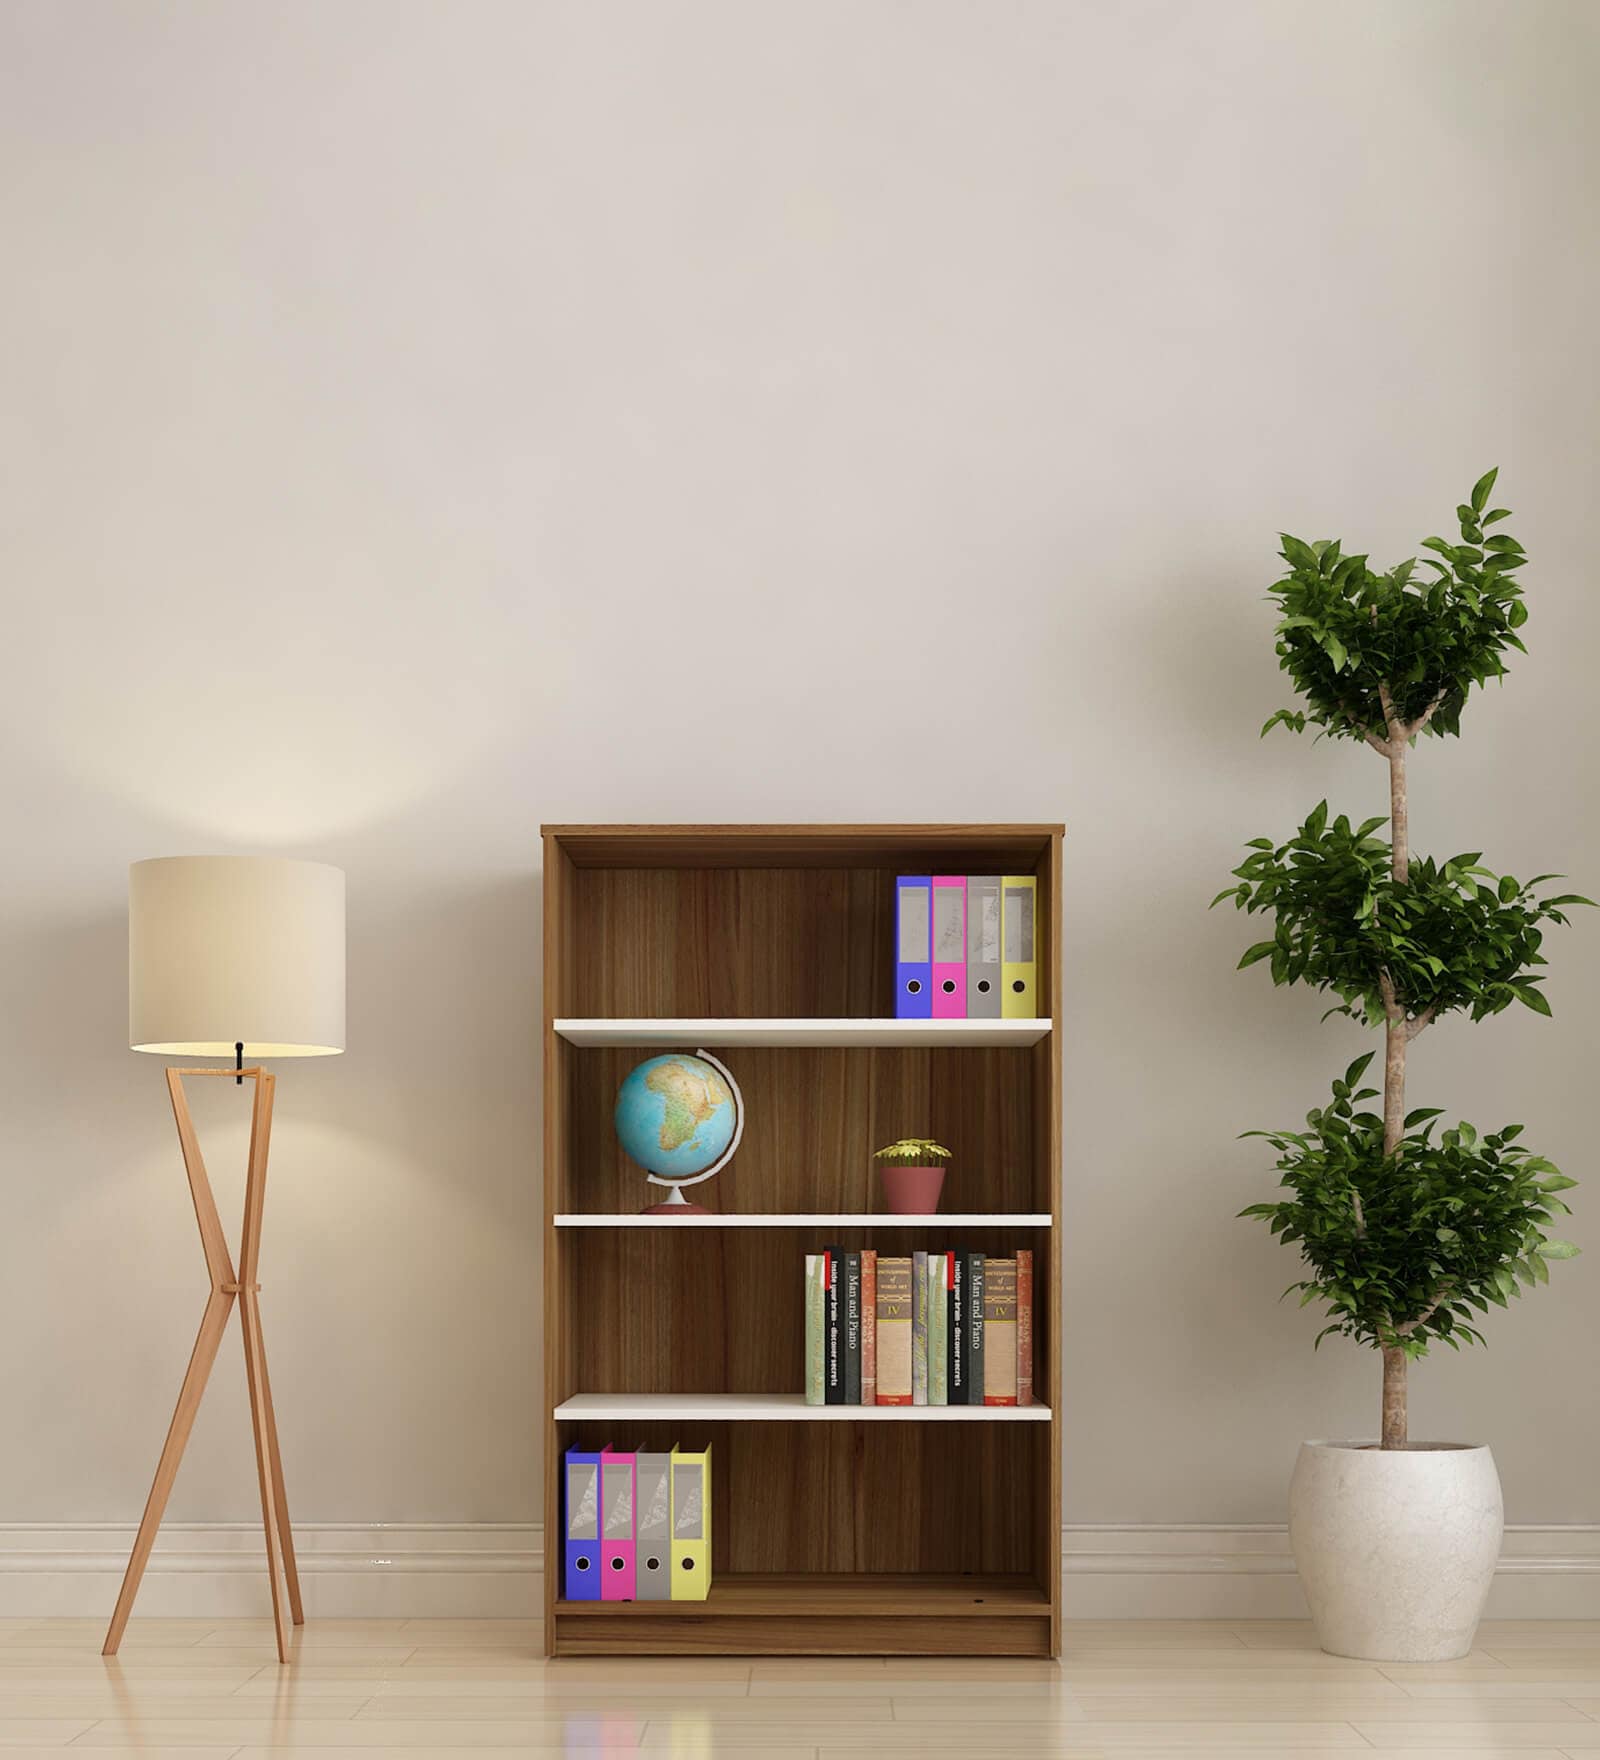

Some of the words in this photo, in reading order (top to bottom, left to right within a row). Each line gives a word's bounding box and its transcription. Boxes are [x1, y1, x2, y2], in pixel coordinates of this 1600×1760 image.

[954, 1261, 962, 1283] Inside
[849, 1275, 859, 1297] Man
[972, 1275, 983, 1297] Man
[849, 1300, 859, 1319] and
[887, 1305, 900, 1315] IV
[972, 1300, 983, 1319] and
[995, 1306, 1008, 1316] IV
[830, 1327, 838, 1359] discover
[849, 1321, 859, 1350] Piano
[972, 1321, 983, 1350] Piano
[830, 1360, 838, 1386] secrets
[954, 1360, 962, 1386] secrets
